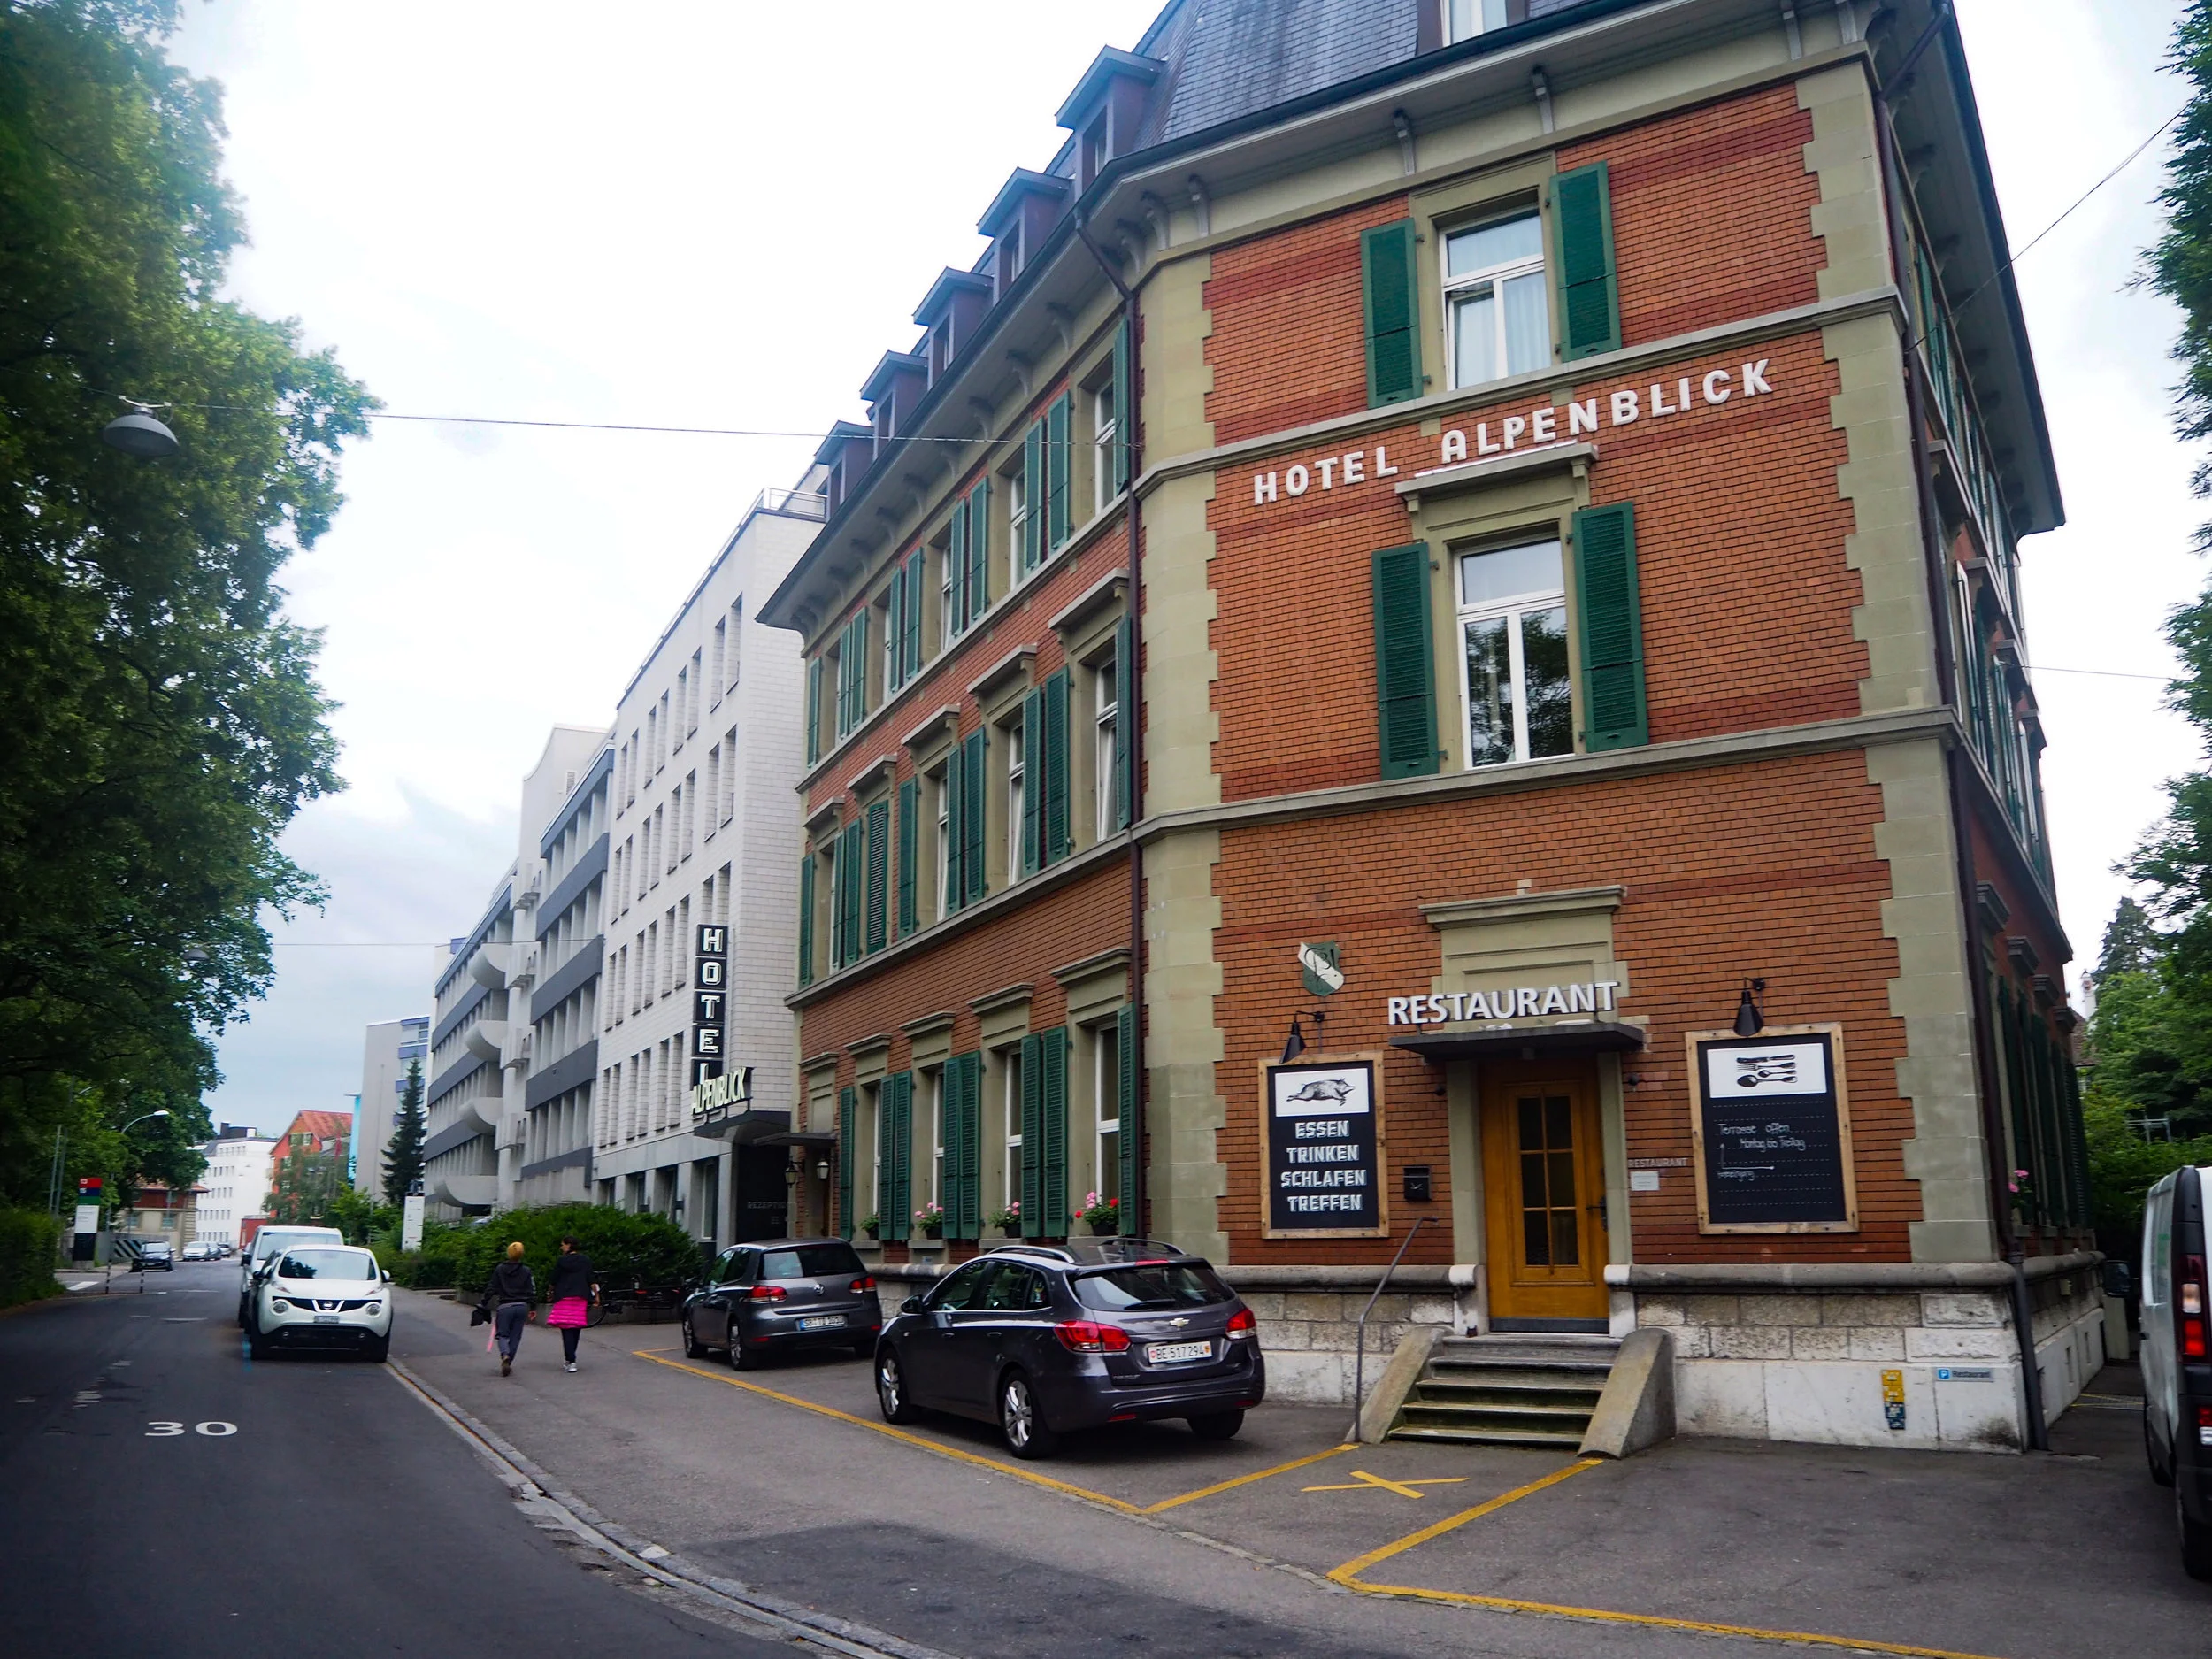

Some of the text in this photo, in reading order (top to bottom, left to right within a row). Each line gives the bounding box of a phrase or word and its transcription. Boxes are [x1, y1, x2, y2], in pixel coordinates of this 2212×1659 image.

[1253, 358, 1773, 505] HOTEL ALPENBLICK
[698, 927, 723, 1087] HOTEL
[1387, 980, 1620, 1025] RESTAURANT
[691, 1067, 746, 1115] ALPENBLICK
[1294, 1119, 1349, 1139] ESSEN
[1286, 1144, 1360, 1164] TRINKEN
[1628, 1157, 1688, 1168] RESTAURANT
[1280, 1169, 1367, 1188] SCHLAFEN
[1287, 1194, 1363, 1213] TREFFEN
[144, 1421, 238, 1436] 30
